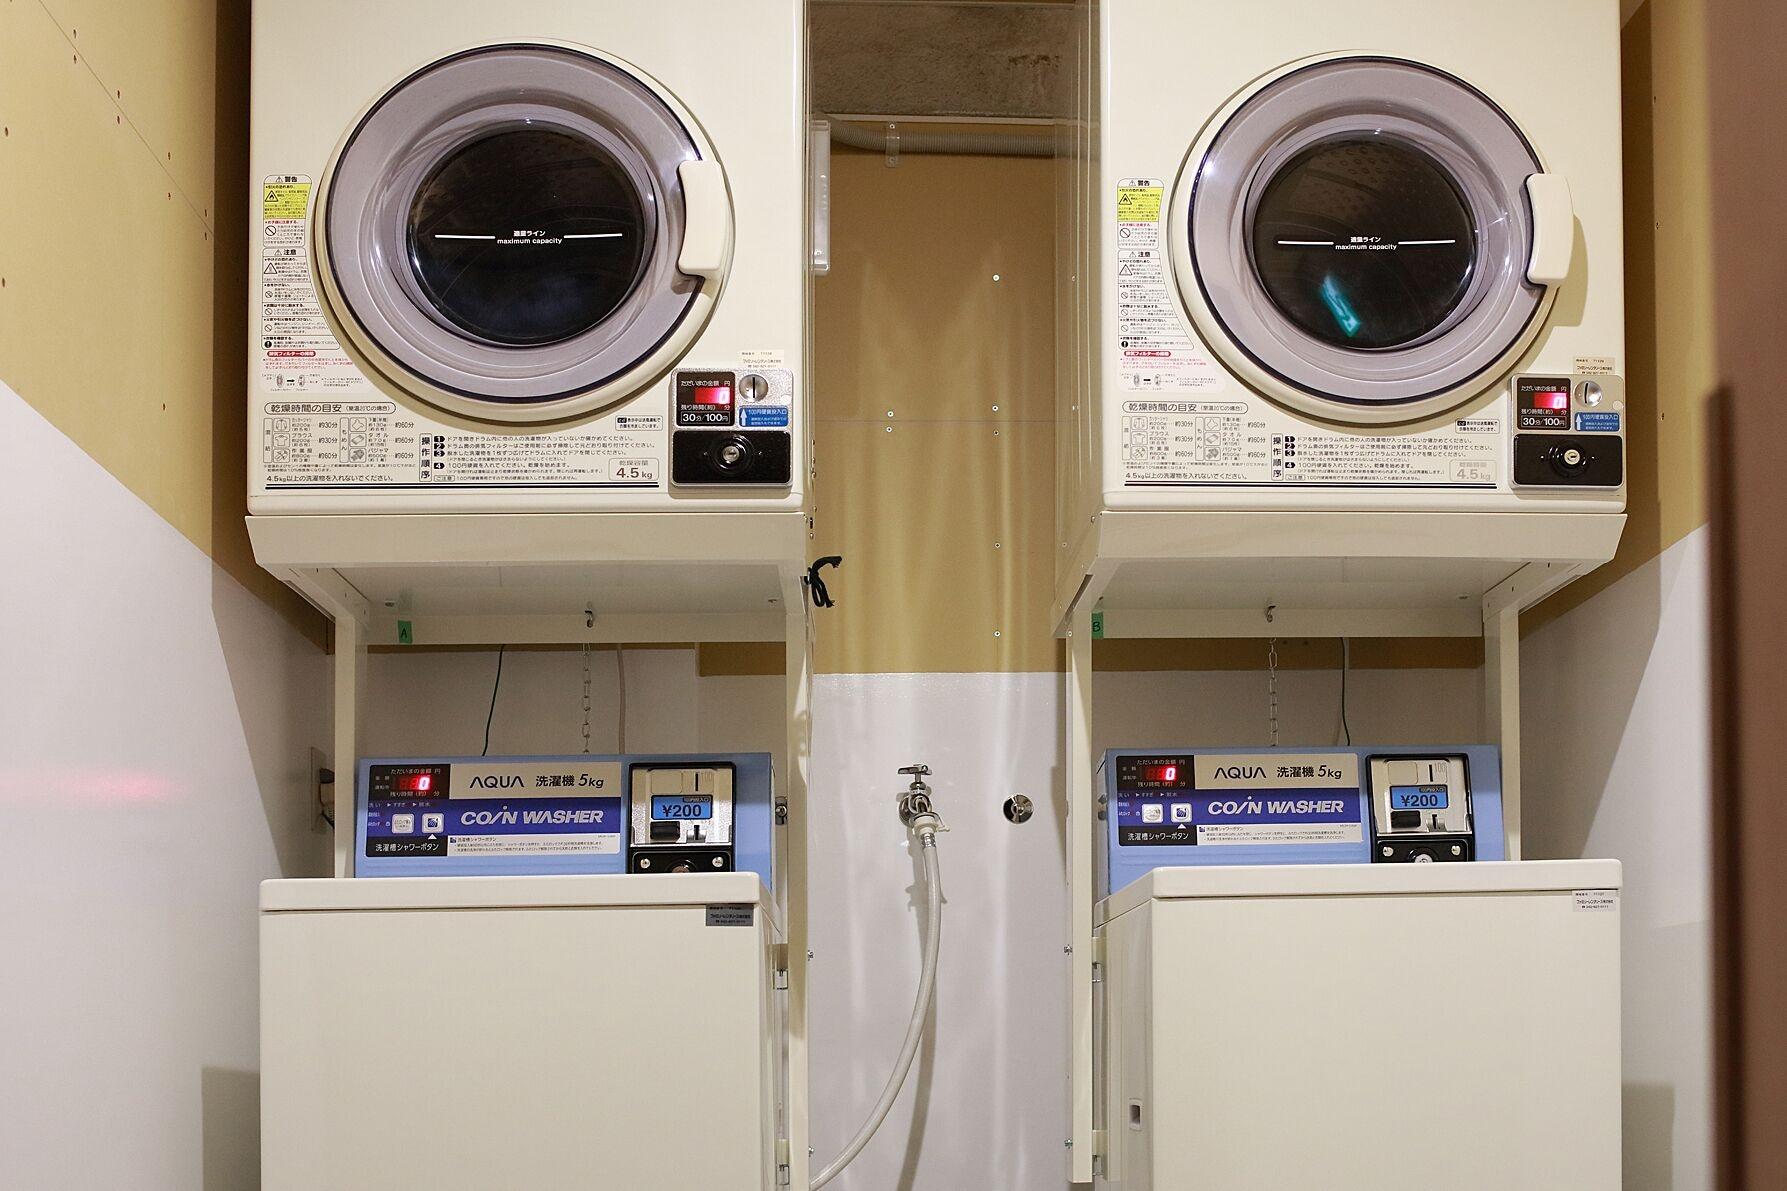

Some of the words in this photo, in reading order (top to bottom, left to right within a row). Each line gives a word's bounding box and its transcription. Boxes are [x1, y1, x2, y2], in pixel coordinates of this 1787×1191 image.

[532, 237, 562, 245] capacity
[1368, 243, 1397, 251] capacity
[271, 404, 342, 413] 乾燥時間の目安
[1128, 403, 1197, 412] 乾燥時間の目安
[395, 421, 414, 429] 約60分
[1174, 420, 1193, 428] 約30分
[1247, 421, 1266, 429] 約60分
[1174, 435, 1193, 443] 約30分
[1247, 436, 1266, 444] 約60分
[319, 452, 338, 460] 約60分
[421, 437, 430, 479] 操作順序
[1174, 450, 1193, 458] 約60分
[1247, 451, 1266, 459] 約60分
[1273, 437, 1281, 477] 操作順序
[616, 467, 639, 478] 4.5
[642, 471, 652, 479] kg
[1125, 472, 1247, 480] 4.5kg以上の洗濯物を入れないでください。
[1456, 469, 1478, 479] 4.5
[1480, 471, 1491, 481] kg
[1092, 621, 1101, 632] B
[400, 627, 408, 638] A
[1165, 767, 1176, 780] 0
[1214, 766, 1267, 779] AQUA
[1276, 766, 1315, 778] 洗濯機
[1317, 765, 1342, 780] 5kg
[418, 776, 430, 790] 0
[469, 775, 524, 788] AQUA
[535, 775, 575, 787] 洗濯機
[578, 774, 604, 789] 5kg
[1400, 794, 1438, 807] ¥200
[662, 804, 702, 817] ¥200
[1267, 800, 1345, 814] WASHER
[523, 810, 603, 824] WASHER
[1127, 832, 1189, 840] 洗濯槽シャワーボタン
[375, 843, 439, 851] 洗濯槽シャワーボタン
